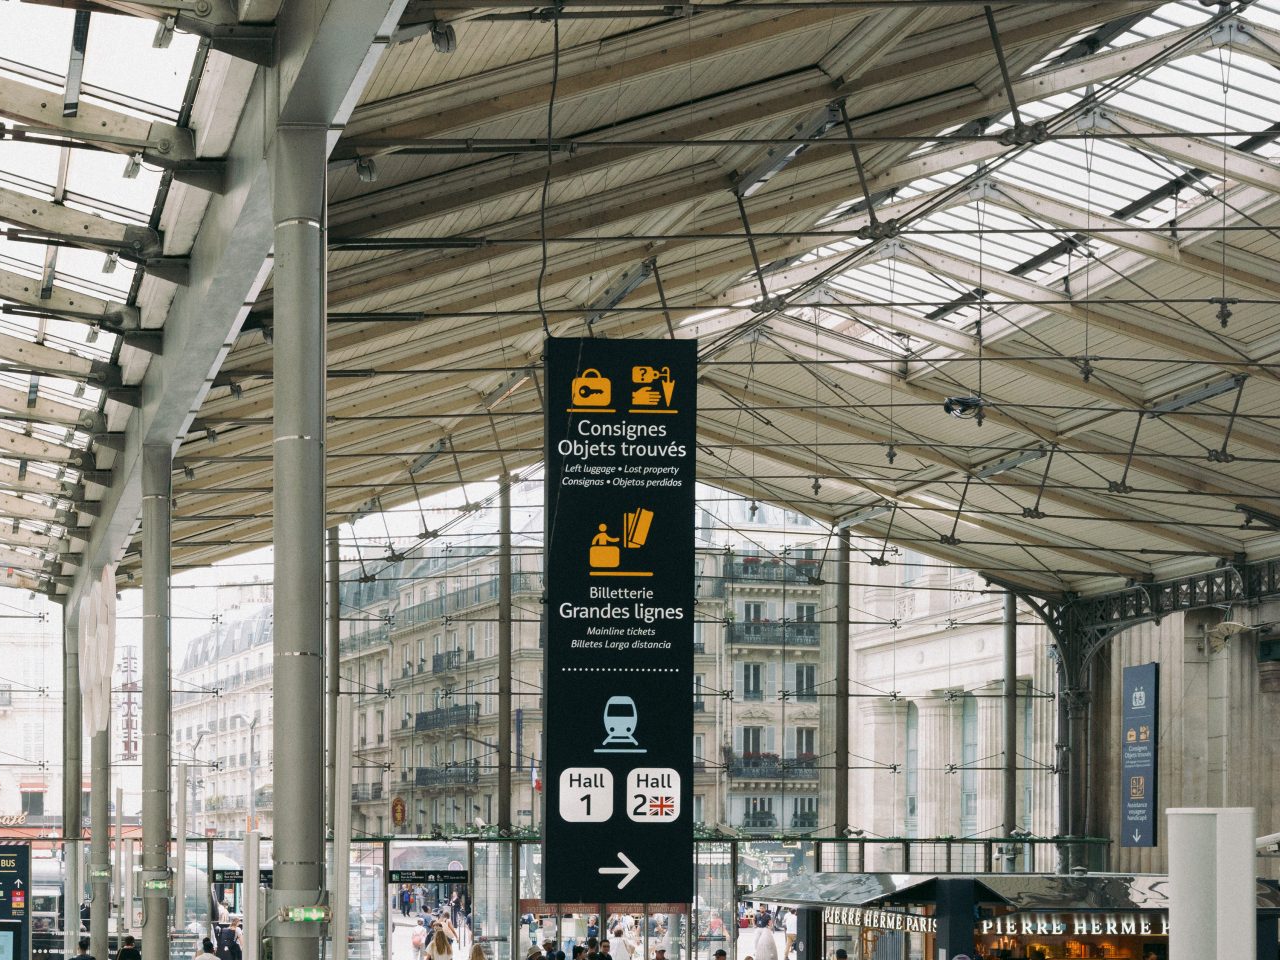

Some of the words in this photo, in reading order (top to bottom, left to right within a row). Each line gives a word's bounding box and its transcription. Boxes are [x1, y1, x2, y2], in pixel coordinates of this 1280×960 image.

[577, 420, 667, 440] Consignes
[558, 439, 616, 460] Objets
[621, 440, 687, 457] trouvés
[565, 463, 582, 474] Left
[583, 464, 616, 476] luggage
[624, 464, 643, 474] Lost
[643, 465, 680, 476] property
[561, 477, 605, 489] Consignas
[612, 477, 645, 488] Objetos
[645, 477, 682, 488] perdidos
[590, 586, 654, 600] Billetterie
[559, 602, 630, 620] Grandes
[635, 603, 684, 623] lignes
[586, 626, 625, 636] Mainline
[626, 626, 656, 636] tickets
[571, 639, 603, 649] Billetes
[605, 640, 630, 651] Larga
[631, 640, 672, 649] distancia
[569, 773, 605, 788] Hall
[636, 774, 672, 789] Hall
[580, 794, 591, 816] 1
[633, 794, 647, 816] 2
[0, 859, 16, 867] BUS
[824, 910, 861, 926] PIERRE
[906, 916, 937, 933] PARIS
[982, 920, 1064, 935] PIERRE
